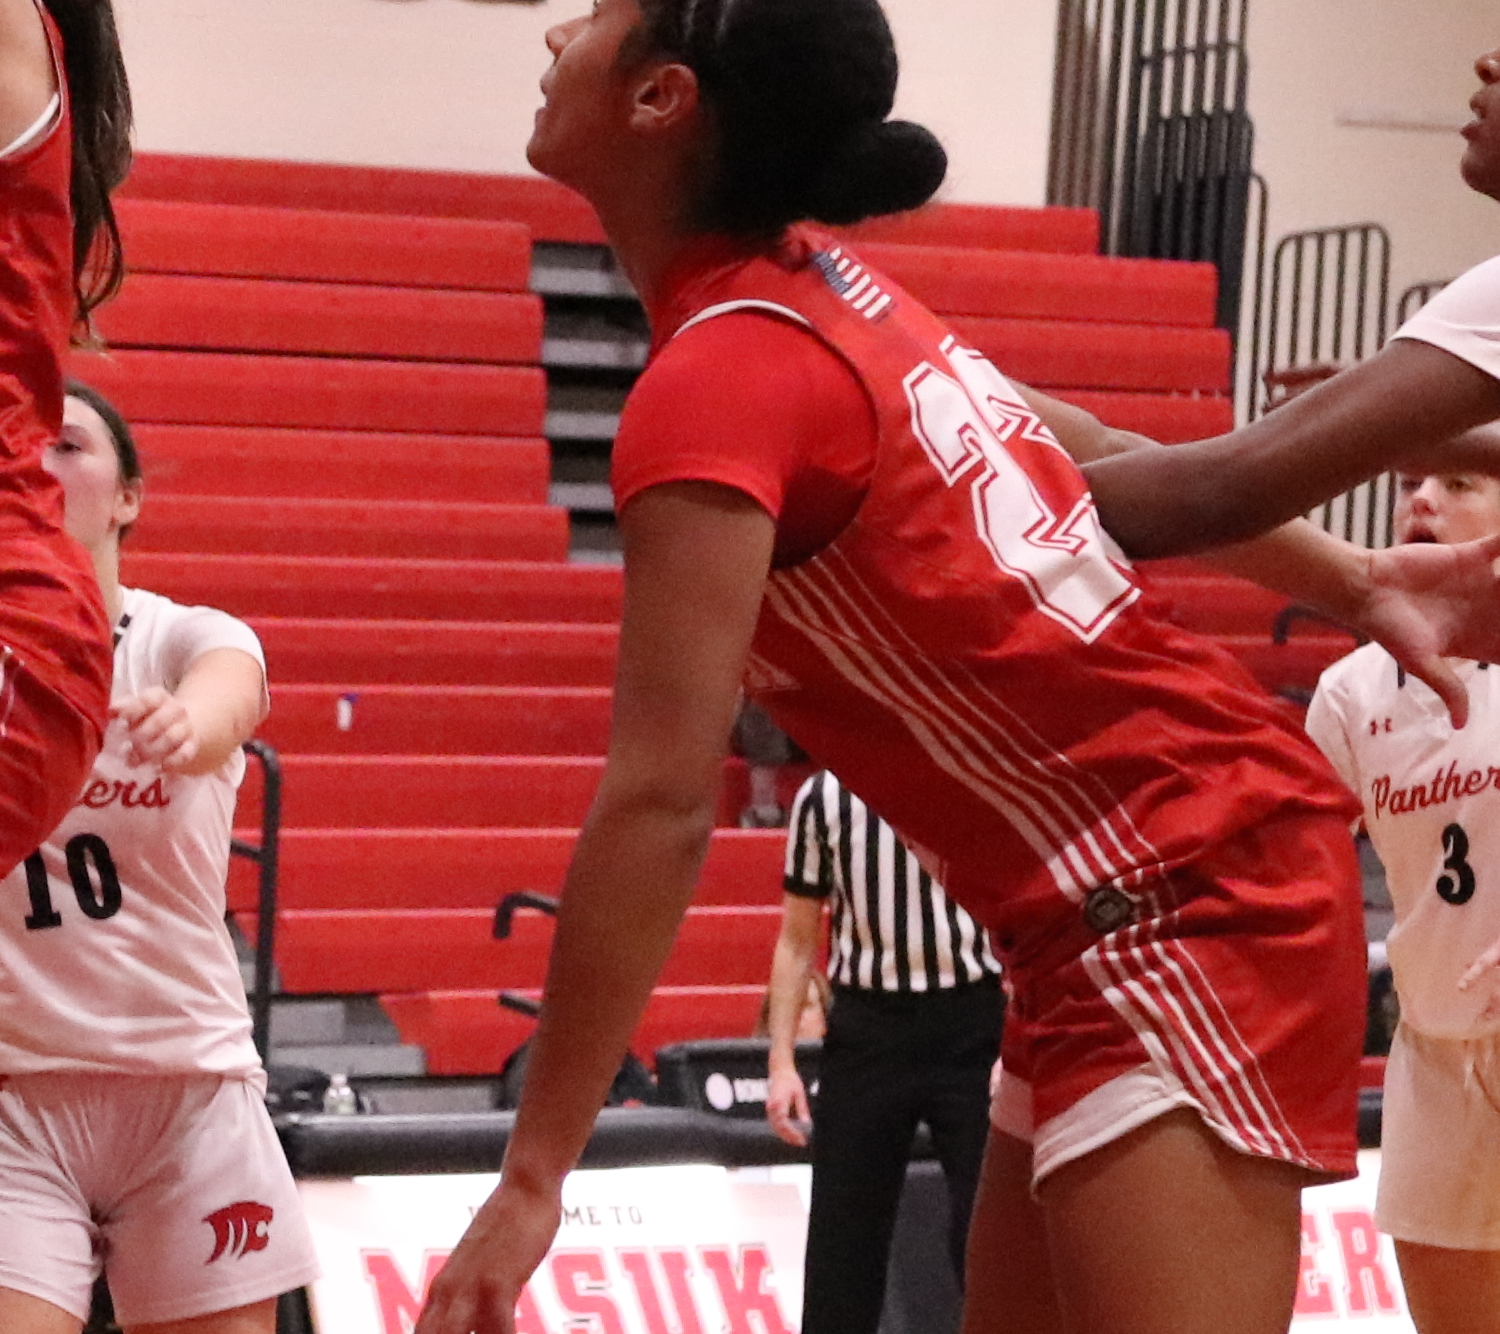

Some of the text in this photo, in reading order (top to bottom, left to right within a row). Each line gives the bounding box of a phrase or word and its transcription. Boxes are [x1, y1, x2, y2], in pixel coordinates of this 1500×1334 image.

[74, 775, 171, 810] ers
[23, 833, 123, 931] 10
[1436, 821, 1476, 906] 3
[608, 1205, 643, 1227] TO
